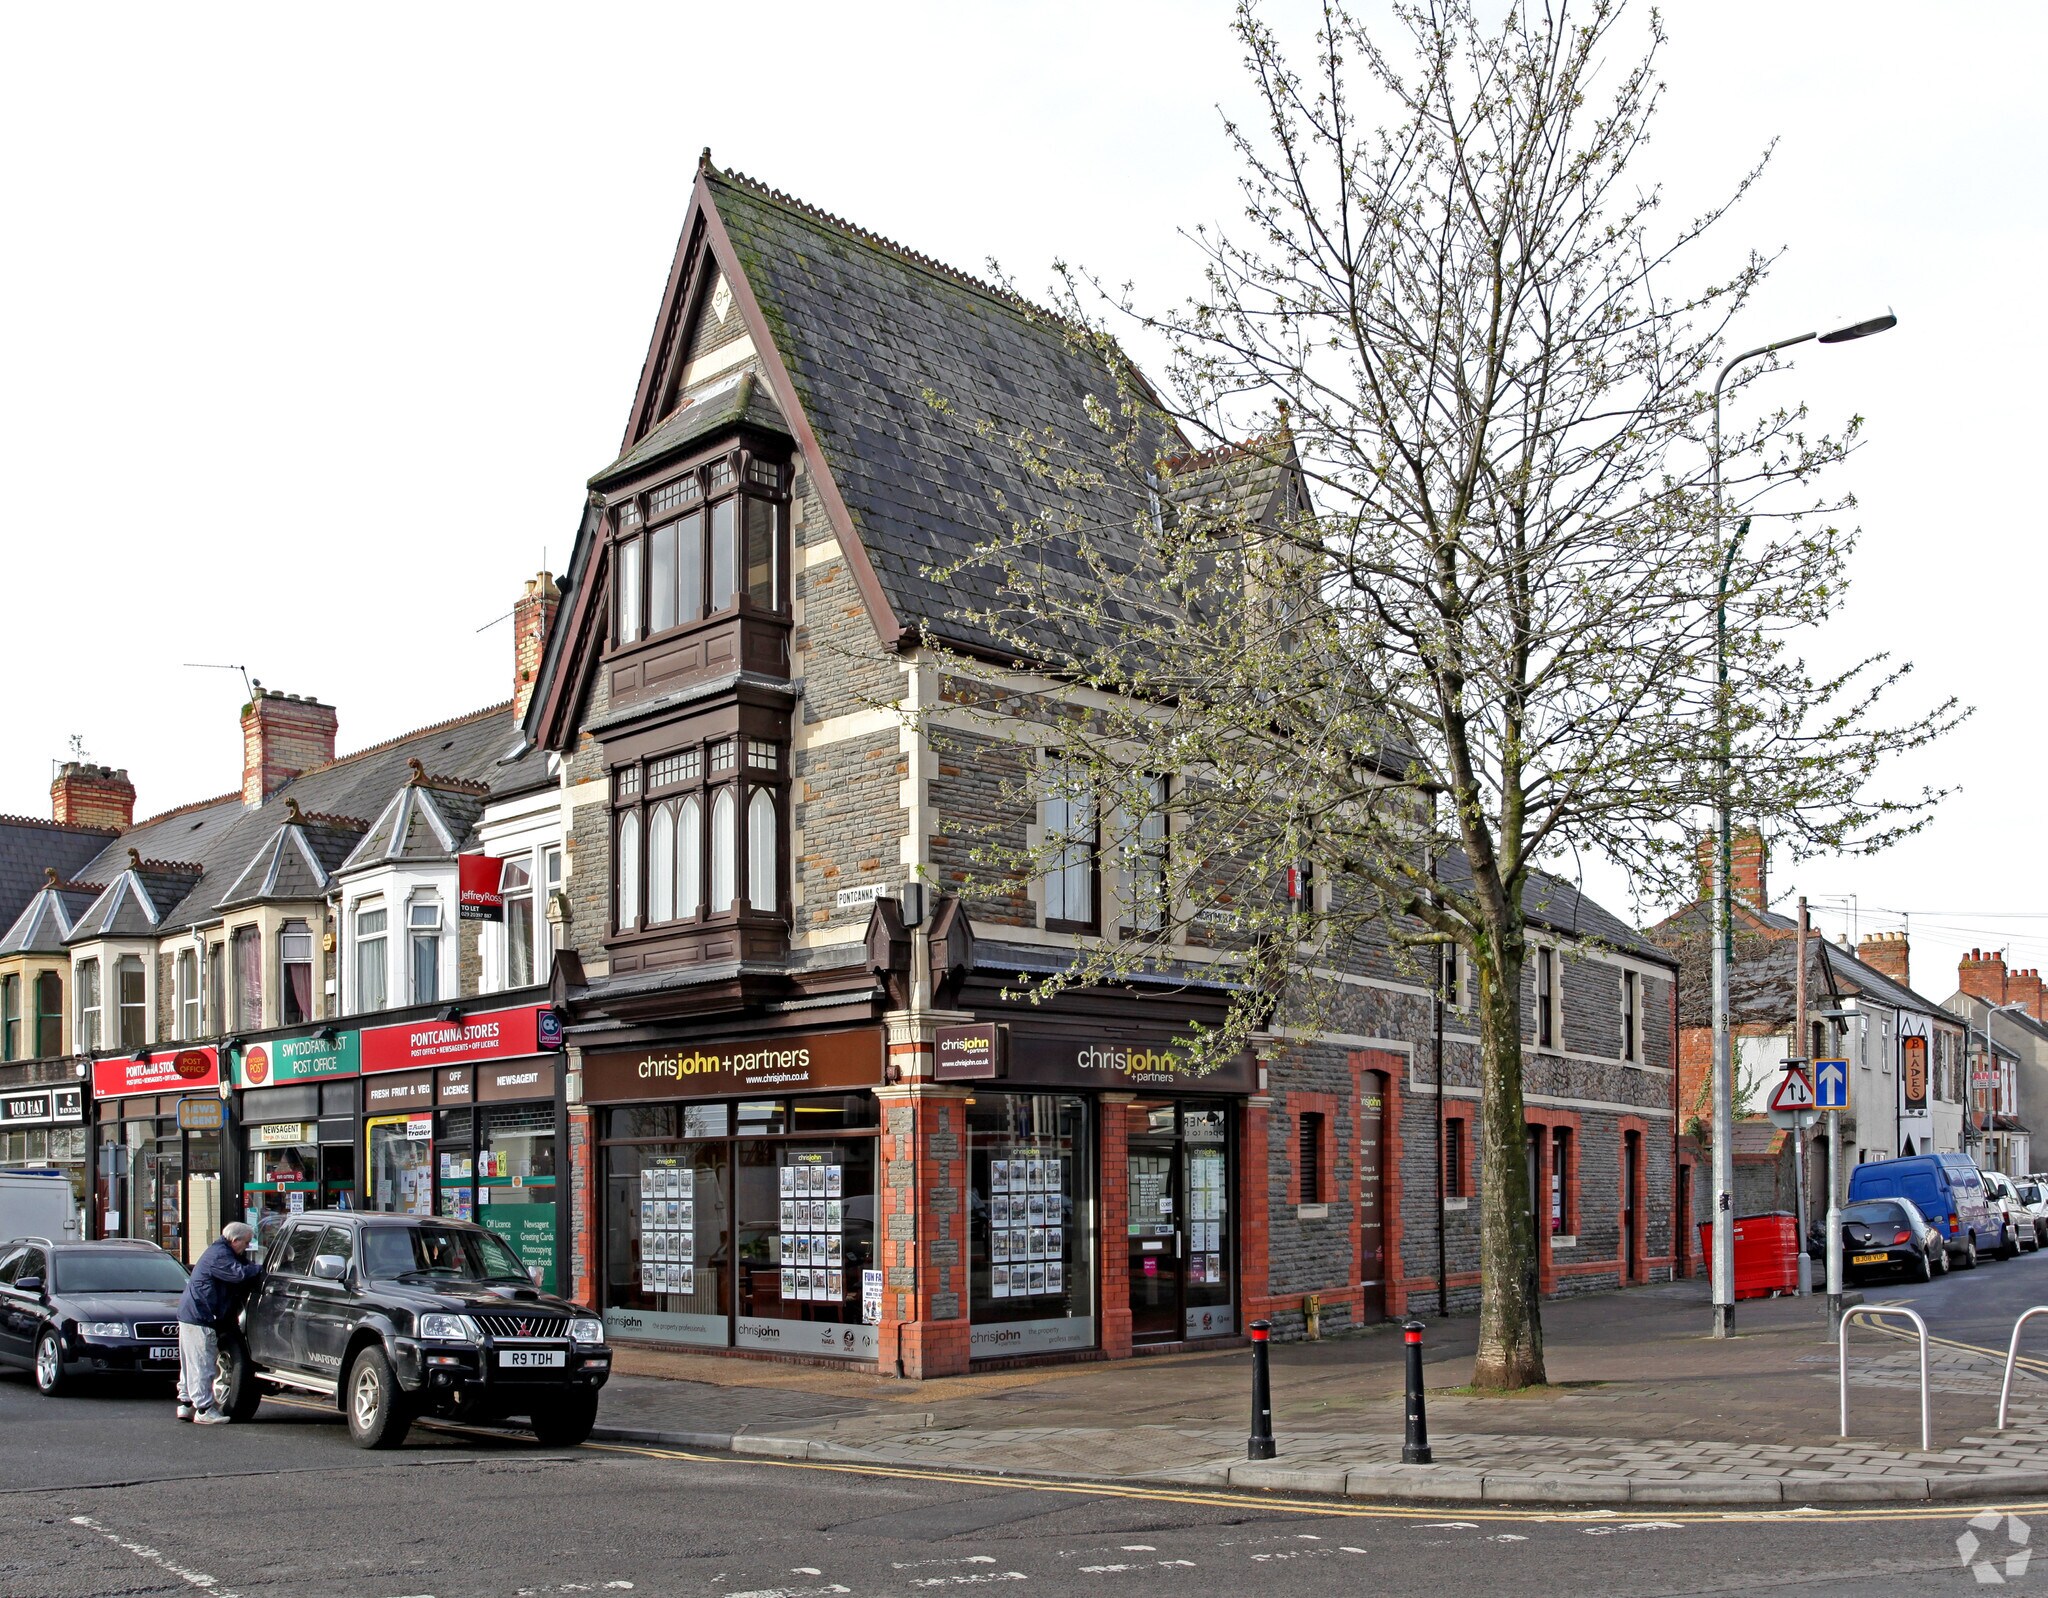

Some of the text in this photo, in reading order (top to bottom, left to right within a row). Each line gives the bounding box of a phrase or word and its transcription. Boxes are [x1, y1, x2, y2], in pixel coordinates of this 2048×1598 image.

[839, 888, 873, 904] PONTCANNA
[411, 1022, 500, 1047] PONTCANNA STORES
[411, 1039, 499, 1057] POST OFFICE NEWSAGENTS OFF LICENCE
[941, 1037, 989, 1051] chrisjohn
[182, 1058, 202, 1066] POST
[293, 1057, 337, 1074] POST OFFICE
[1077, 1045, 1175, 1075] chrisjohn
[180, 1065, 206, 1074] OFFICE
[249, 1063, 264, 1074] POST
[1911, 1039, 1921, 1099] BLADES
[450, 1071, 462, 1081] OFF
[497, 1072, 538, 1086] NEWSAGENT
[746, 1071, 809, 1084] www.chrisjohn.co.uk
[371, 1084, 430, 1100] FRESH FRUIT & VEG
[443, 1084, 469, 1096] LICENCE
[10, 1101, 27, 1116] TOP
[27, 1100, 44, 1114] HAT
[184, 1116, 218, 1125] AGENT
[263, 1124, 299, 1134] NEWSAGENT
[486, 1220, 511, 1228] Off Licence
[523, 1220, 549, 1230] Newsagent
[520, 1232, 554, 1243] Greeting Cards
[522, 1245, 552, 1256] Photocopying
[522, 1257, 537, 1266] Frozen
[538, 1257, 552, 1266] Foods
[738, 1324, 780, 1338] chrisjohn
[970, 1329, 1021, 1344] chrisjohn
[512, 1353, 553, 1365] R9 TDH
